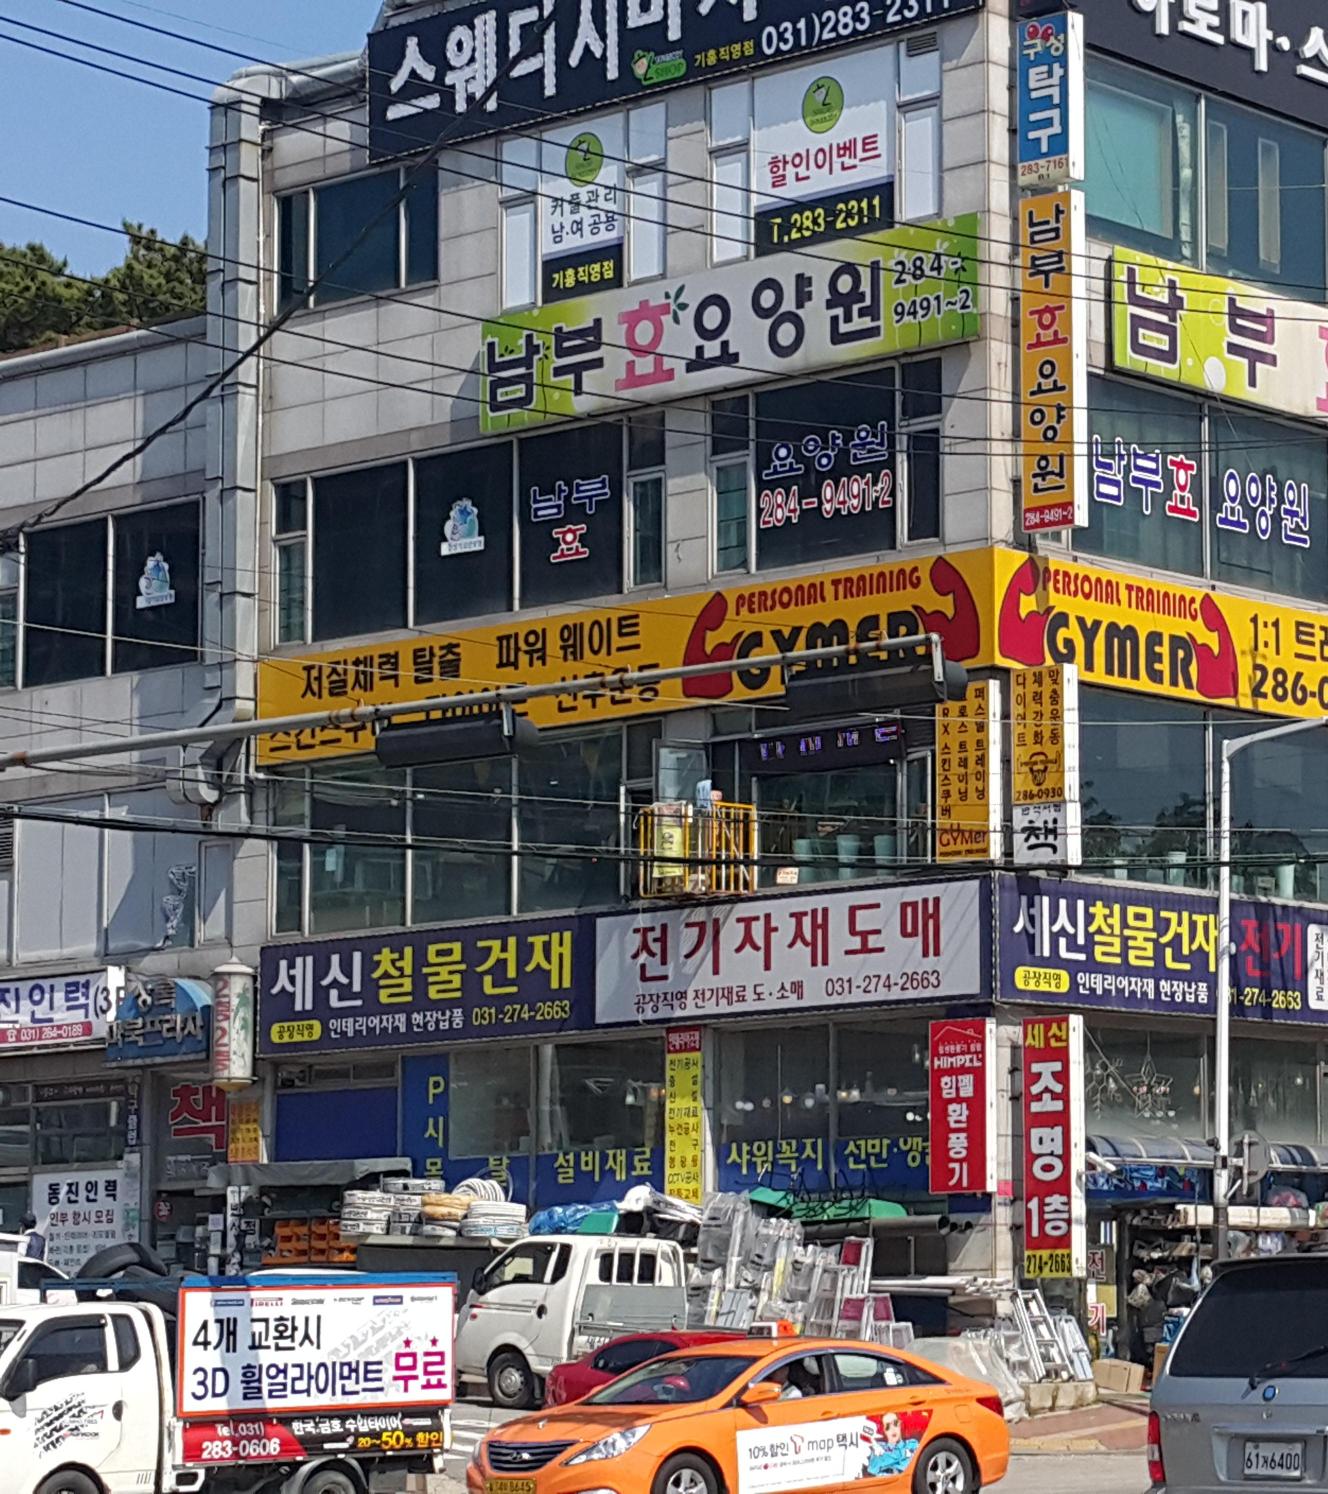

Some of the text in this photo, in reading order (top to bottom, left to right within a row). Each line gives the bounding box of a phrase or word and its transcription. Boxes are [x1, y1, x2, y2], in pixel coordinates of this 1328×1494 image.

[1023, 37, 1064, 61] 구성
[1027, 62, 1064, 154] 탁구
[768, 133, 882, 189] 할인이벤트
[1020, 158, 1069, 177] 283-7161
[770, 195, 881, 243] T.283-2311
[552, 259, 615, 289] 기흥직영점
[762, 420, 888, 481] 요양원
[530, 475, 611, 523] 남부
[1216, 468, 1310, 548] 요양원
[549, 524, 590, 563] 효
[735, 565, 922, 617] PERSONAL TRAINING
[1042, 567, 1199, 622] PERSONAL TRAINING
[1046, 609, 1197, 692] GYMER
[1248, 613, 1281, 657] 1:1
[301, 613, 642, 701] 저질체력 탈출 파워 웨이트
[1016, 786, 1063, 801] 286-0930
[1240, 919, 1302, 981] 전기
[692, 985, 749, 1008] 전기재료
[825, 969, 943, 998] 031-274-2663
[1076, 971, 1155, 1001] 인테리어자재
[1159, 980, 1209, 1004] 현장납품
[328, 1012, 407, 1038] 인테리어자재
[411, 1008, 466, 1032] 현장납품
[472, 1000, 571, 1027] 031-274-2663
[1025, 1021, 1068, 1049] 세신
[940, 1074, 974, 1098] 힘펠
[168, 1081, 227, 1152] 책
[1030, 1060, 1065, 1182] 조명
[726, 1137, 823, 1175] 샤워꼭지
[946, 1103, 970, 1188] 환풍기
[553, 1147, 653, 1185] 설비재료
[48, 1179, 118, 1206] 동진인력
[94, 1209, 115, 1224] 모집
[1027, 1195, 1070, 1238] 1층
[1026, 1254, 1071, 1275] 274-2663
[191, 1314, 323, 1354] 4개 교환시
[190, 1350, 448, 1402] 3D 휠얼라이먼트 무료
[201, 1437, 281, 1459] 283-0606
[416, 1431, 443, 1449] 할인
[836, 1431, 859, 1451] 택시
